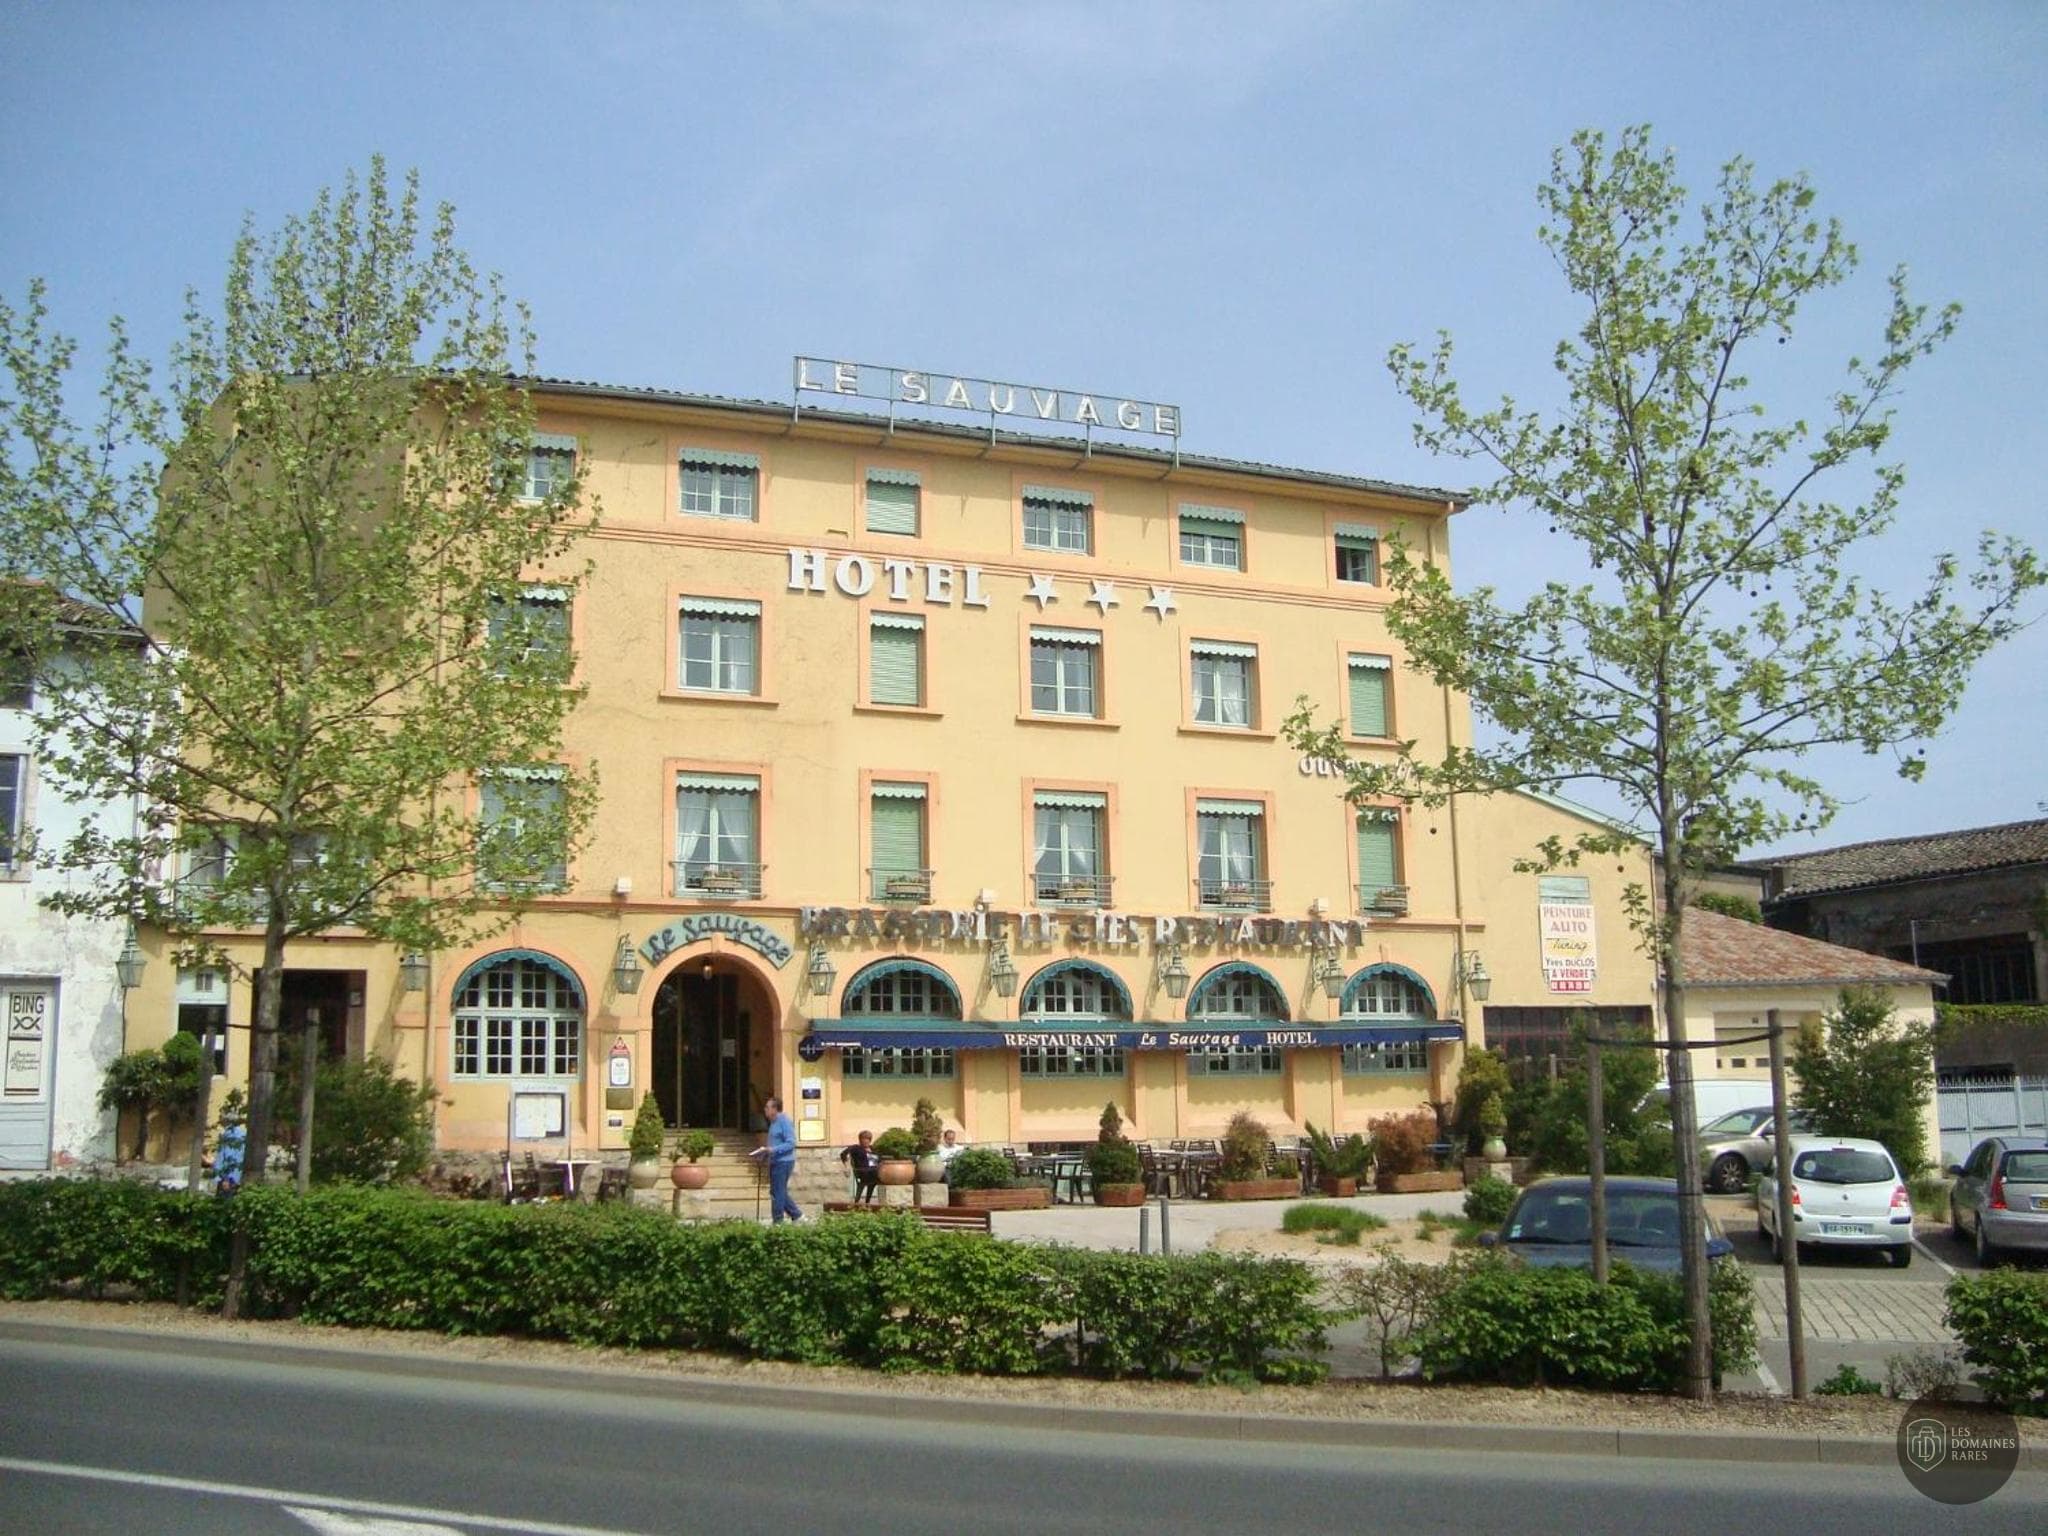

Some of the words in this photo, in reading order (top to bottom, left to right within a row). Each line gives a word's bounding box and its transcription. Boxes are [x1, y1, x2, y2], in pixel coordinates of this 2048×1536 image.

[800, 357, 858, 394] LE
[901, 370, 1176, 435] SAUVAGE
[787, 548, 990, 608] HOTEL
[1544, 906, 1591, 919] PEINTURE
[1551, 921, 1587, 932] AUTO
[648, 927, 676, 963] Le
[682, 915, 790, 961] Sauvage
[1560, 969, 1589, 979] VENDRE
[13, 995, 45, 1014] BING
[1005, 1033, 1118, 1047] RESTAURANT
[1141, 1032, 1157, 1046] Le
[1168, 1032, 1240, 1047] Sauvage
[1266, 1031, 1317, 1045] HOTEL
